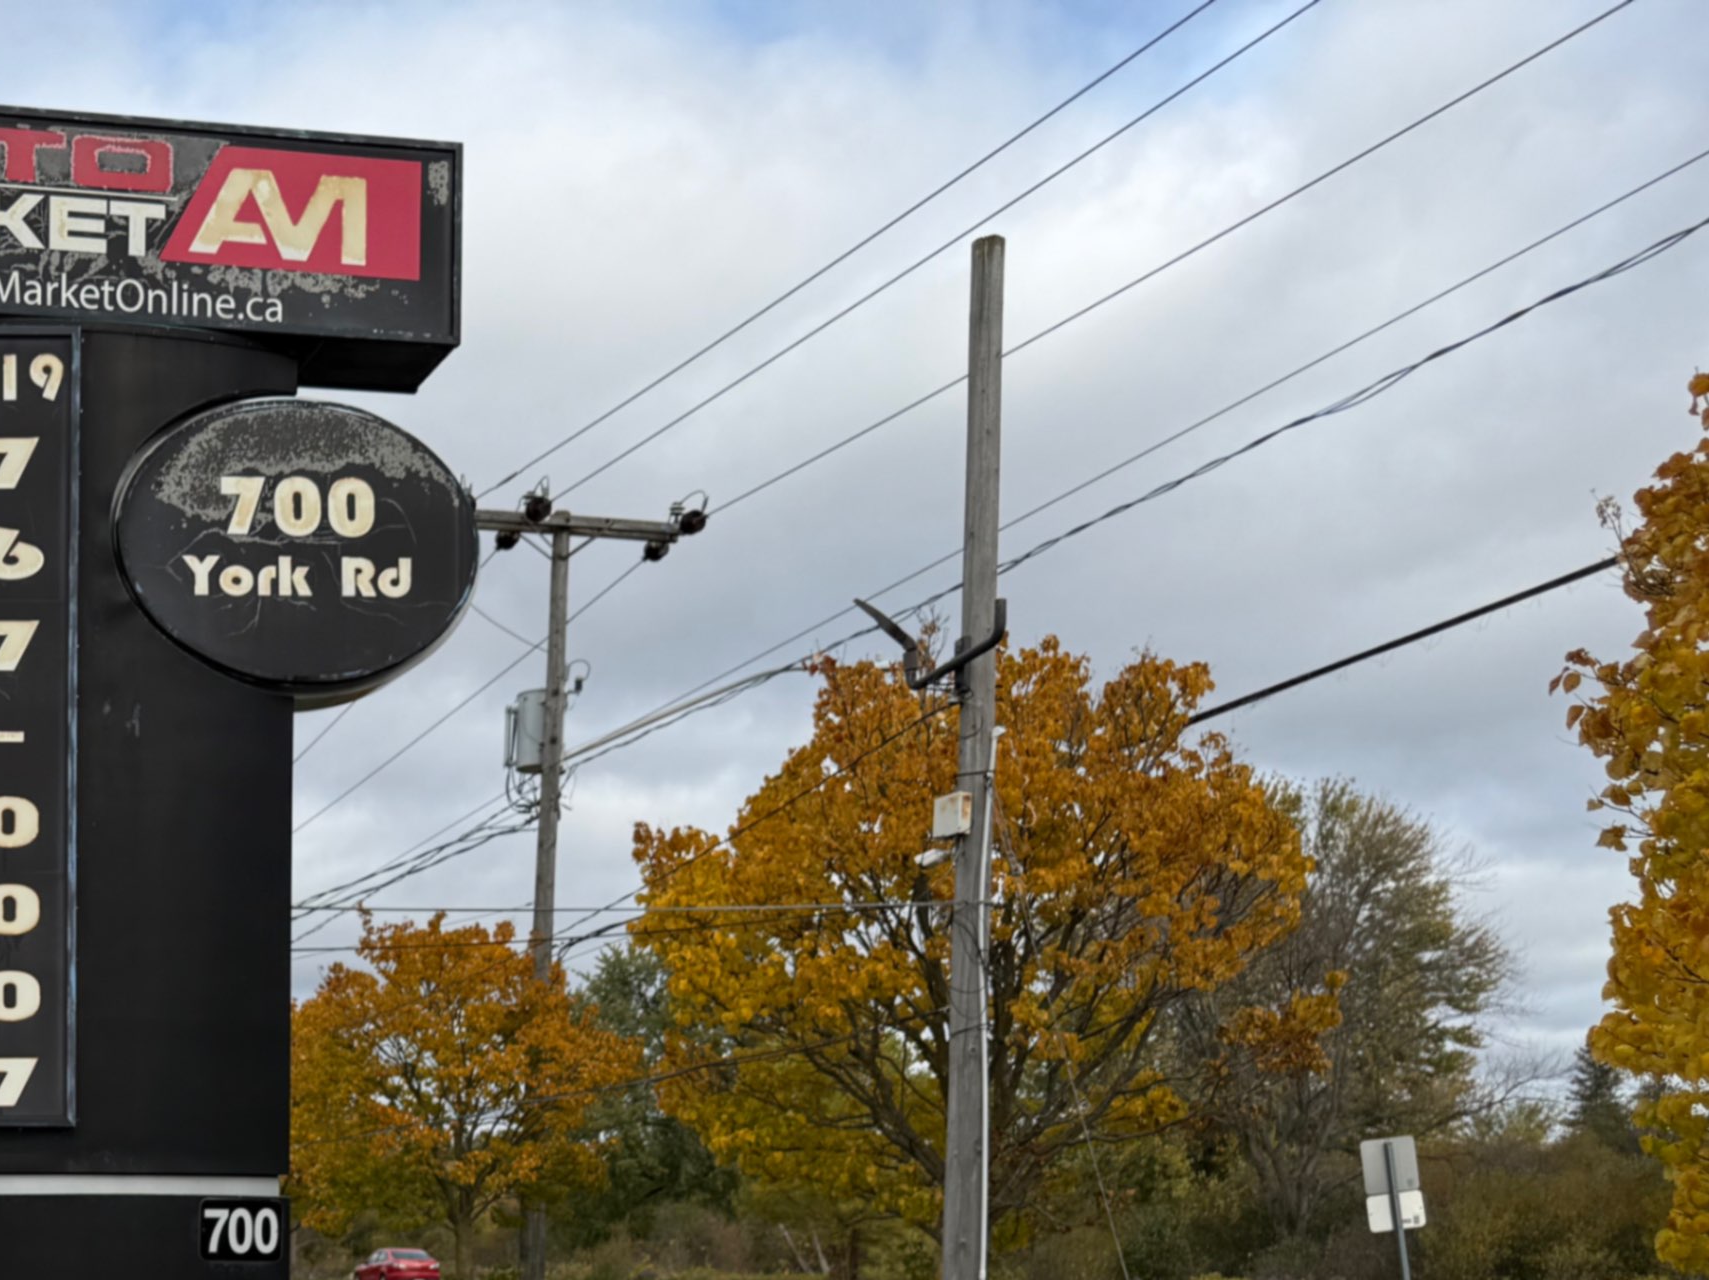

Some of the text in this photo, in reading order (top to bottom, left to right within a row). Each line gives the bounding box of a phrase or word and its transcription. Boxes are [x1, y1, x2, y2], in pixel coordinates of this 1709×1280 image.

[220, 475, 375, 538] 700
[182, 554, 413, 598] York Rd
[203, 1207, 279, 1254] 700
